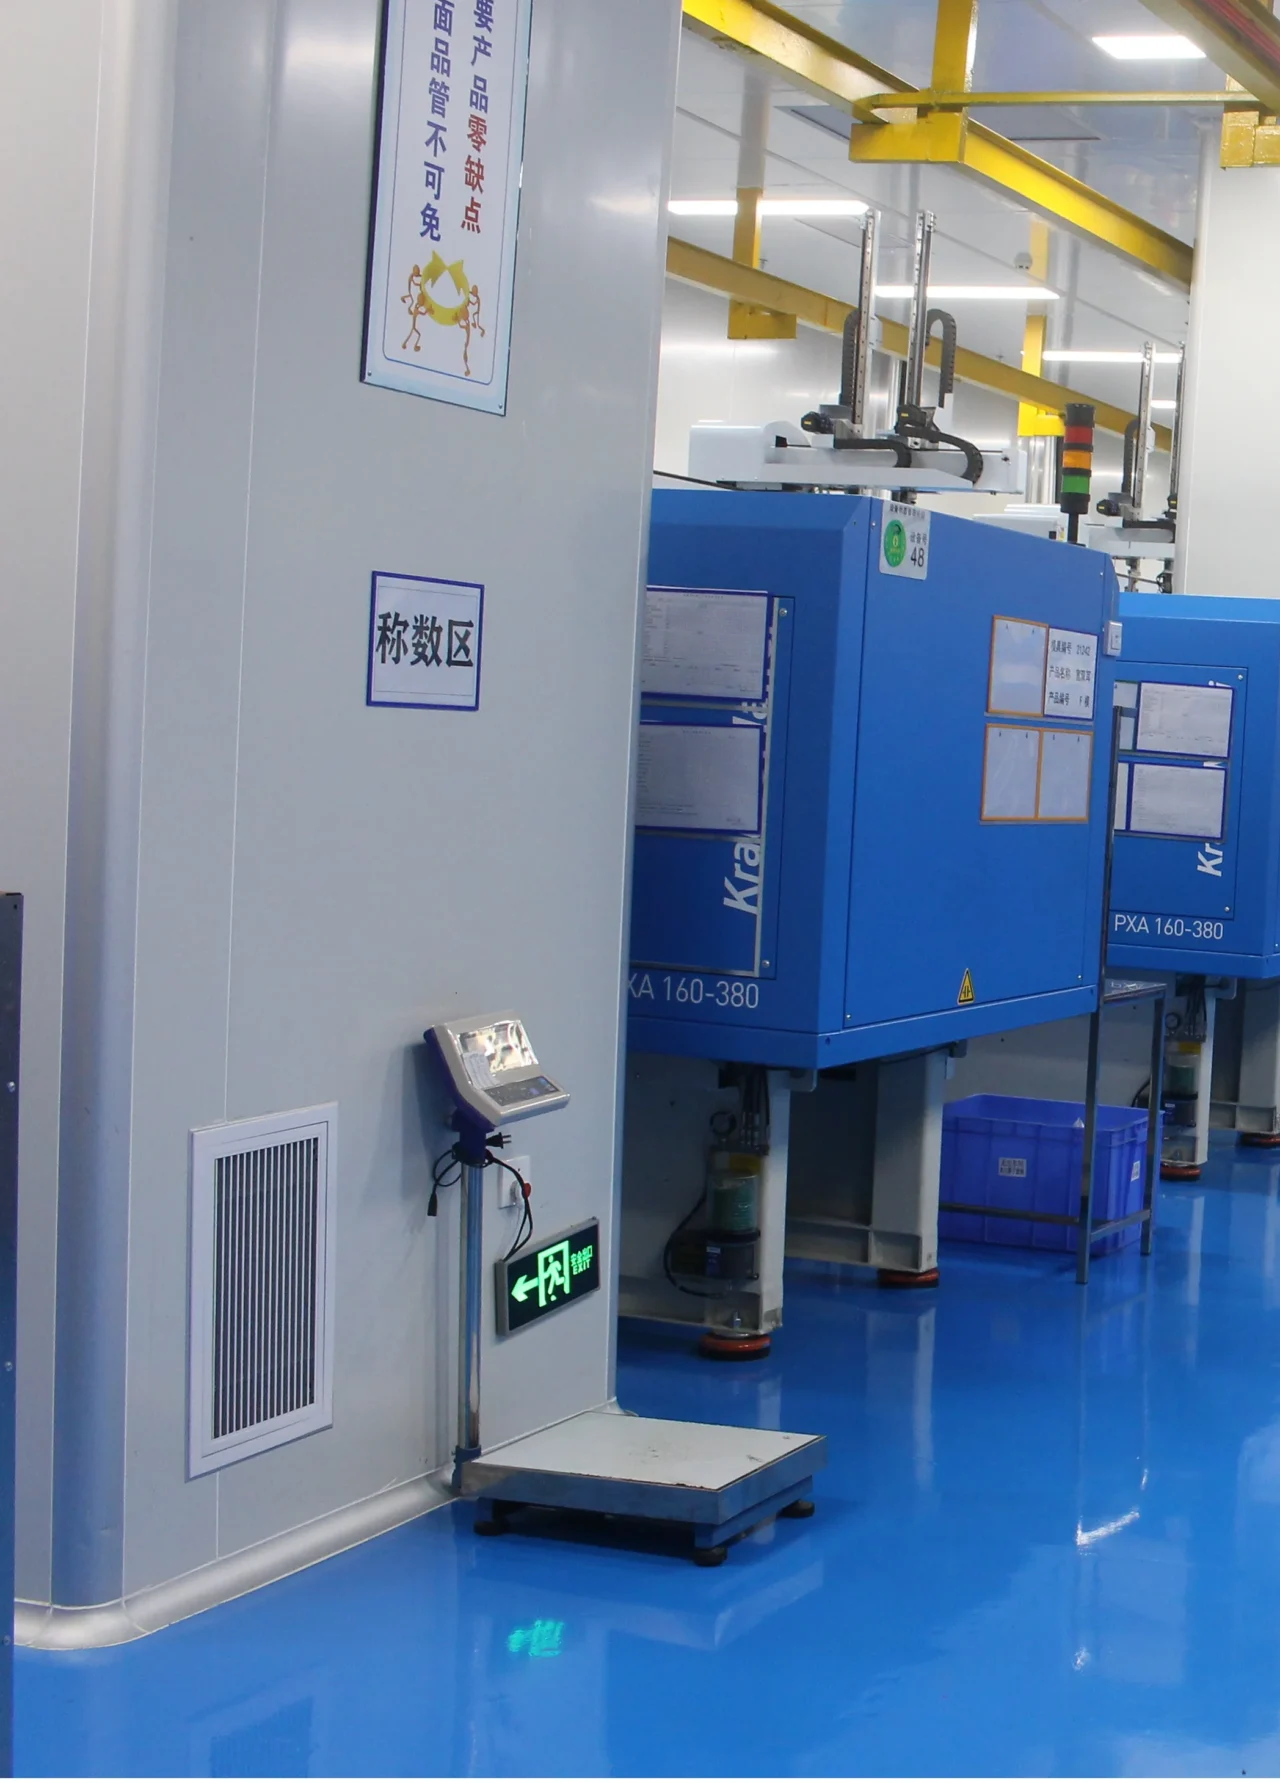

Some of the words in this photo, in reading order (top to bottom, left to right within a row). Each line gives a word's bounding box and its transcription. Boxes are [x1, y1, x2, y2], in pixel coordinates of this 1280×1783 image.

[419, 0, 455, 242] 面品管不可免
[910, 546, 925, 568] 48
[376, 611, 474, 668] 称数区
[1114, 914, 1150, 934] PXA
[1155, 917, 1224, 940] 160-380
[627, 972, 655, 1000] XA
[663, 975, 759, 1009] 160-380
[570, 1245, 593, 1267] 安全出口
[572, 1258, 591, 1276] EXIT
